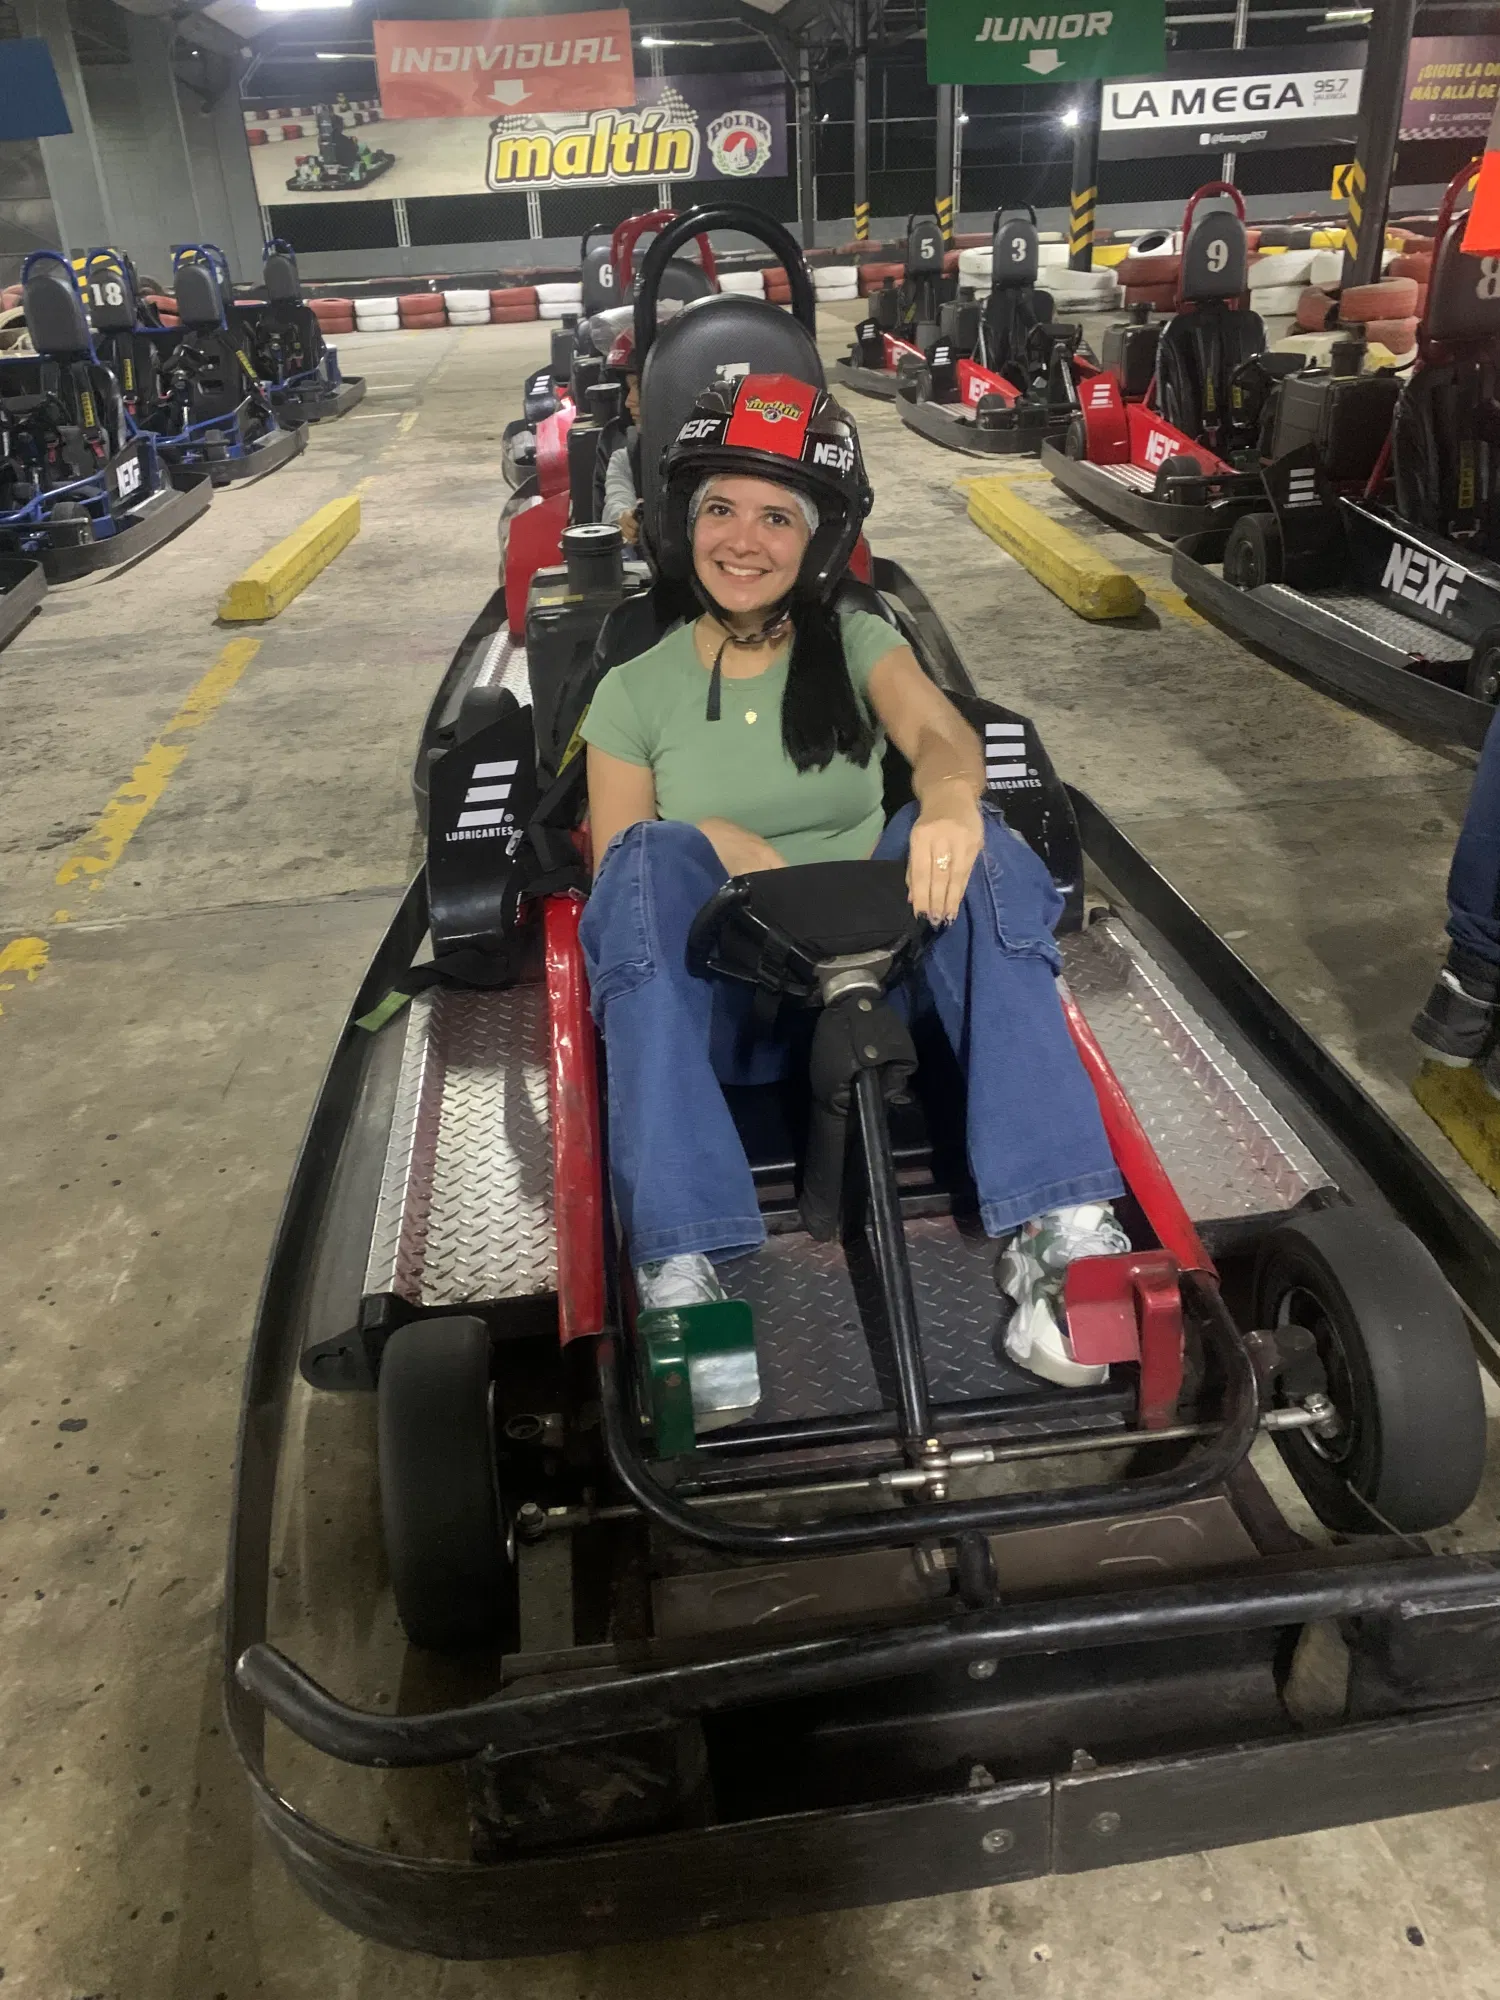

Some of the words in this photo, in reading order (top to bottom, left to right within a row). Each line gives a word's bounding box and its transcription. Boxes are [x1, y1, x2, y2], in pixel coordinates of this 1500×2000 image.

[975, 11, 1113, 42] JUNIOR
[390, 36, 621, 73] INDIVIDUAL
[1464, 63, 1482, 77] LA
[1112, 91, 1159, 120] LA
[1171, 82, 1304, 115] MEGA
[1410, 82, 1440, 100] MÁS
[1441, 81, 1476, 99] ALLÁ
[1477, 84, 1497, 98] DE
[711, 114, 768, 140] POLAR
[495, 112, 692, 181] maltín
[920, 238, 935, 259] 5
[1012, 238, 1027, 262] 3
[1206, 239, 1229, 273] 9
[599, 264, 613, 287] 6
[1476, 256, 1500, 299] 8
[90, 282, 123, 306] 18
[445, 826, 514, 842] LUBRICANTES
